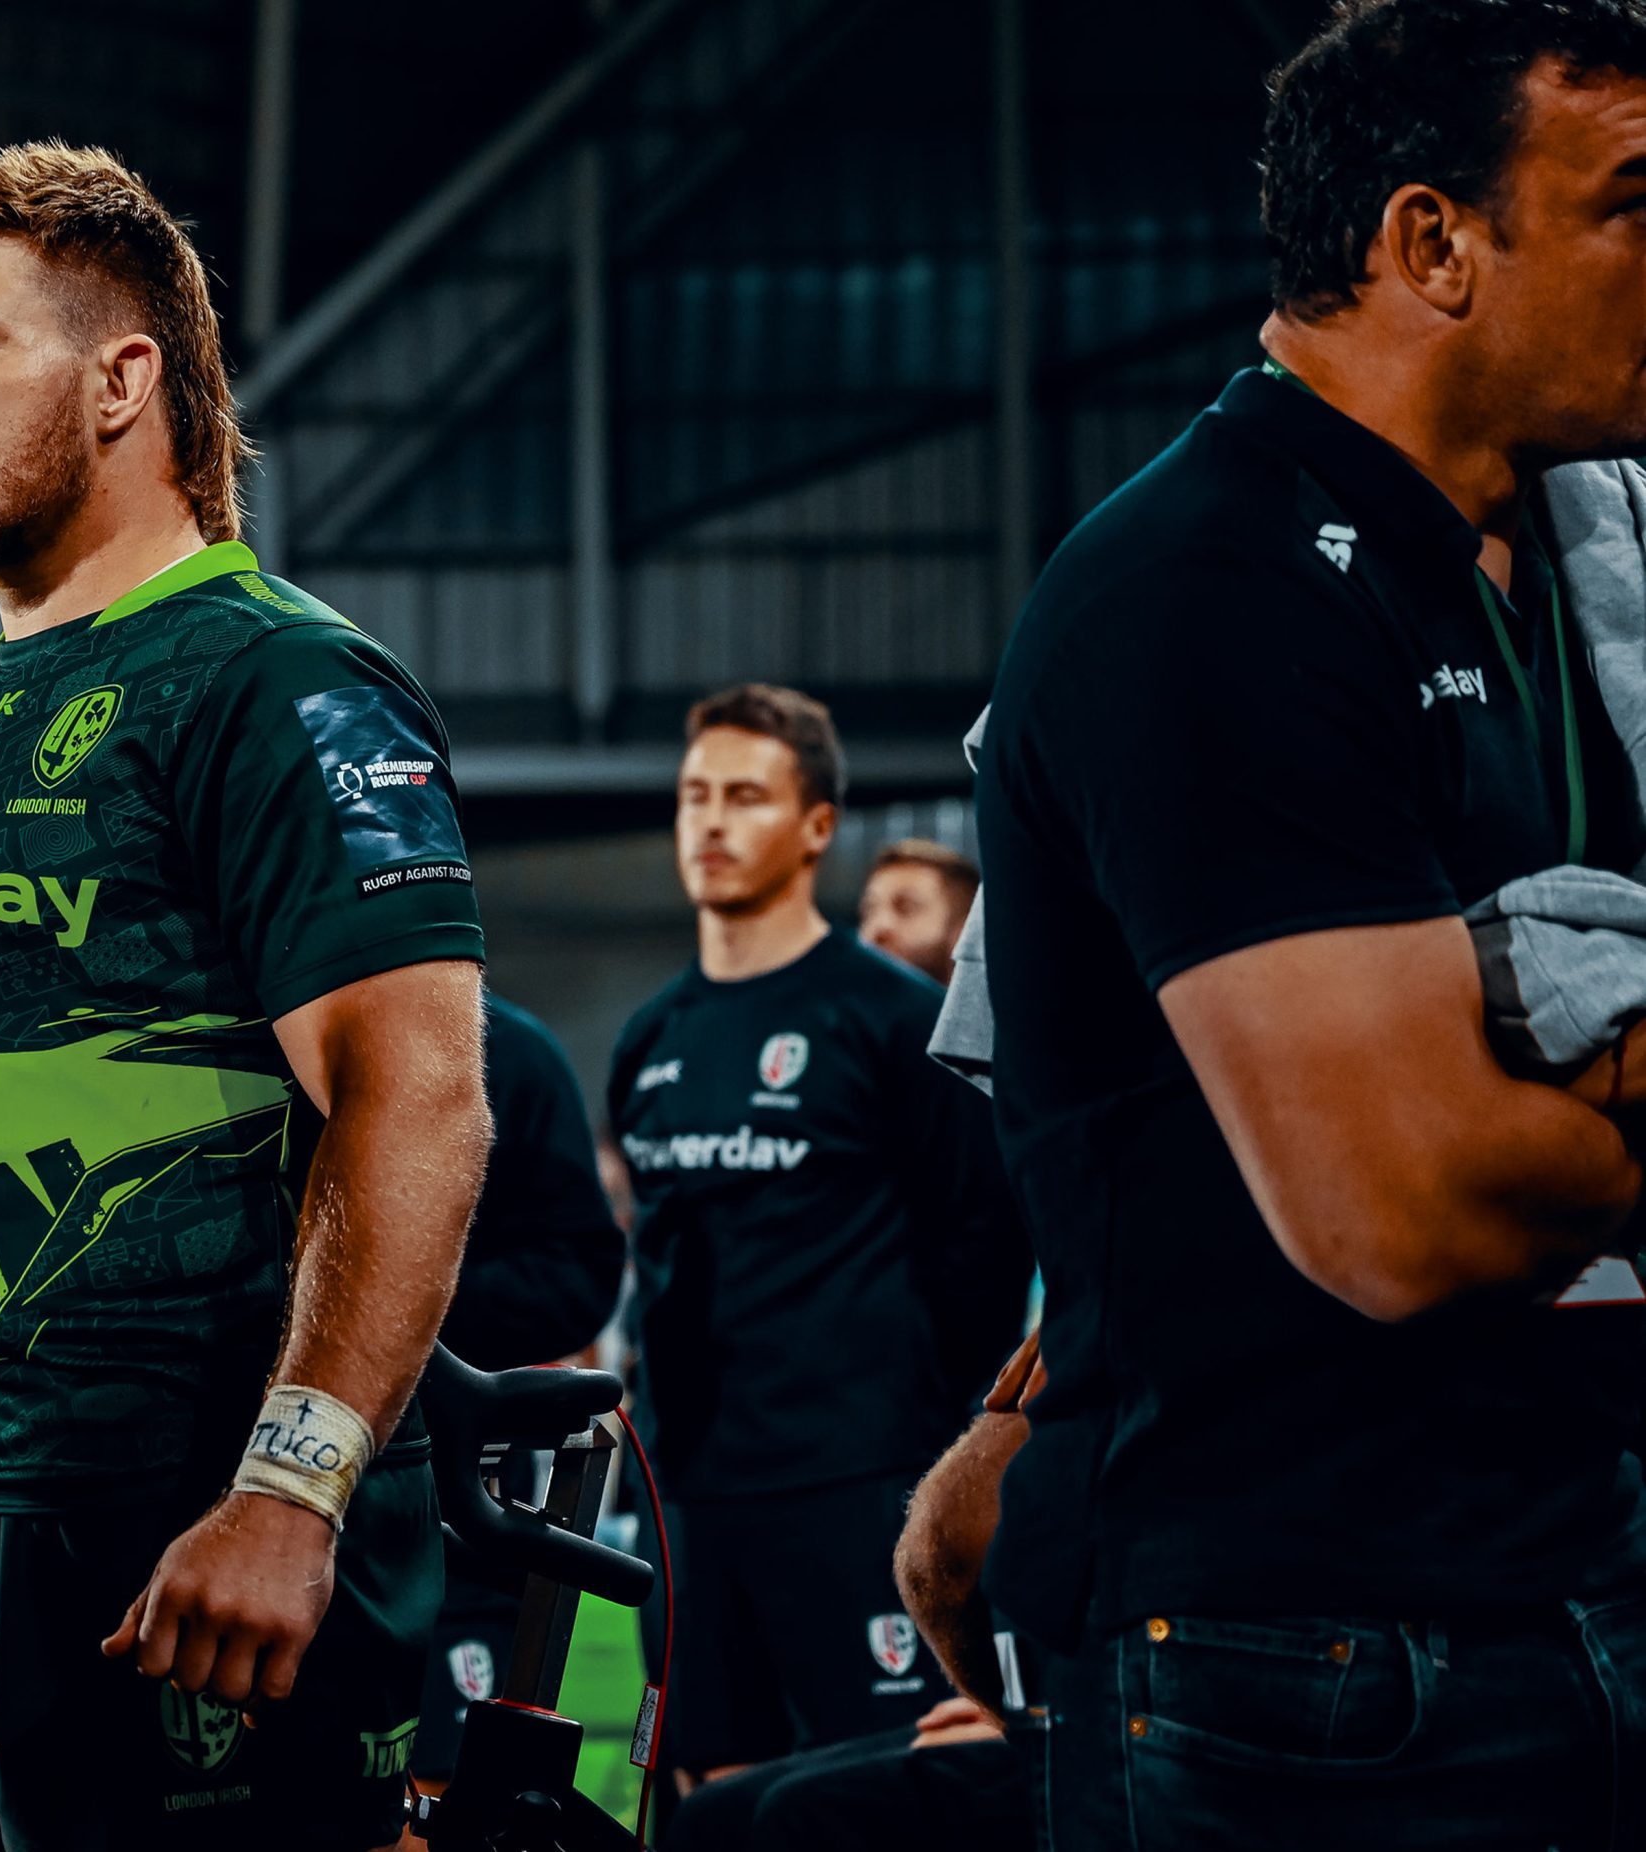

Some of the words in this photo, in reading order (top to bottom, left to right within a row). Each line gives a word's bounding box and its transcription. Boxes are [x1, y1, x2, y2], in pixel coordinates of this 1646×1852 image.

[366, 761, 434, 775] PREMIERSHIP
[372, 775, 409, 788] RUGBY
[411, 775, 427, 785] CUP
[6, 798, 52, 815] LONDON
[53, 798, 87, 815] IRISH
[363, 871, 403, 892] RUGBY
[406, 866, 448, 882] AGAINST
[164, 1790, 216, 1813] LONDON
